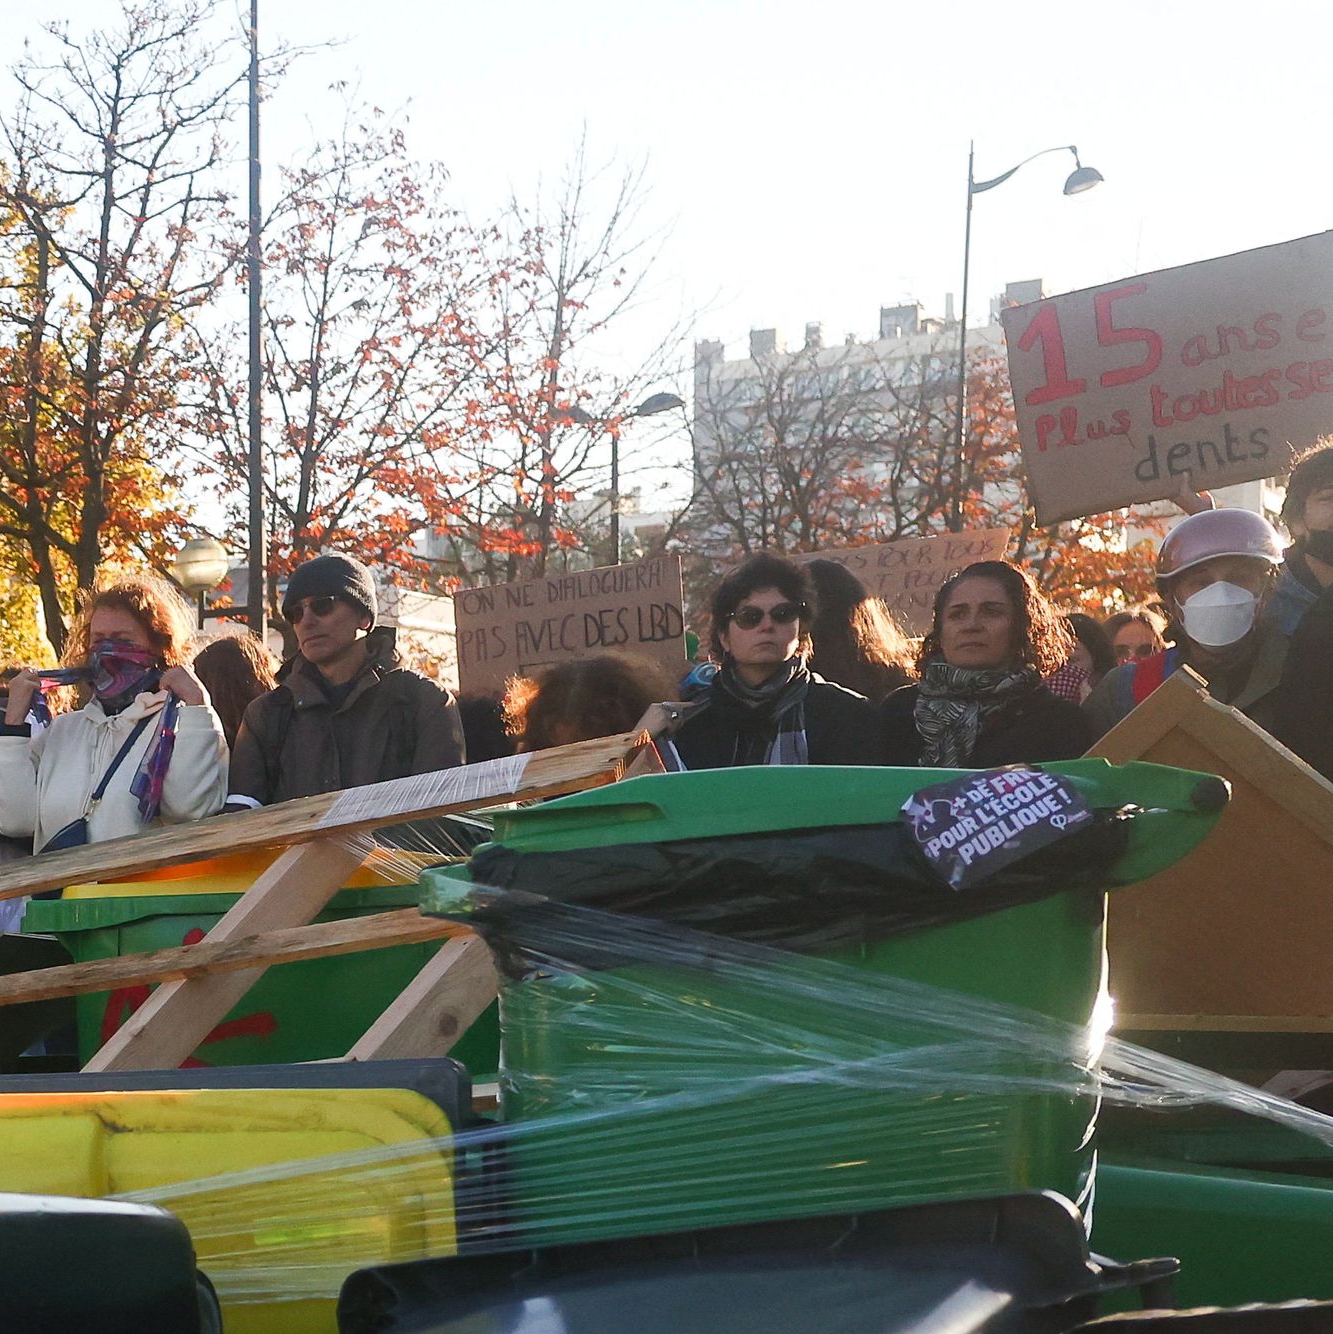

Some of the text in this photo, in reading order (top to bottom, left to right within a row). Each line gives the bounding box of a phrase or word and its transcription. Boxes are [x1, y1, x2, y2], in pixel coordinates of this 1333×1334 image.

[1017, 283, 1163, 406] 15
[1182, 313, 1283, 367] ans
[1035, 406, 1133, 451] Plus
[1150, 368, 1282, 428] toutes
[1135, 424, 1271, 481] dents
[460, 603, 683, 667] PAS AVEC DES LBD
[462, 591, 494, 615] ON
[506, 584, 533, 609] NE
[927, 774, 1059, 858] POUR L'ÉCOLE
[958, 794, 1063, 865] PUBLIQUE
